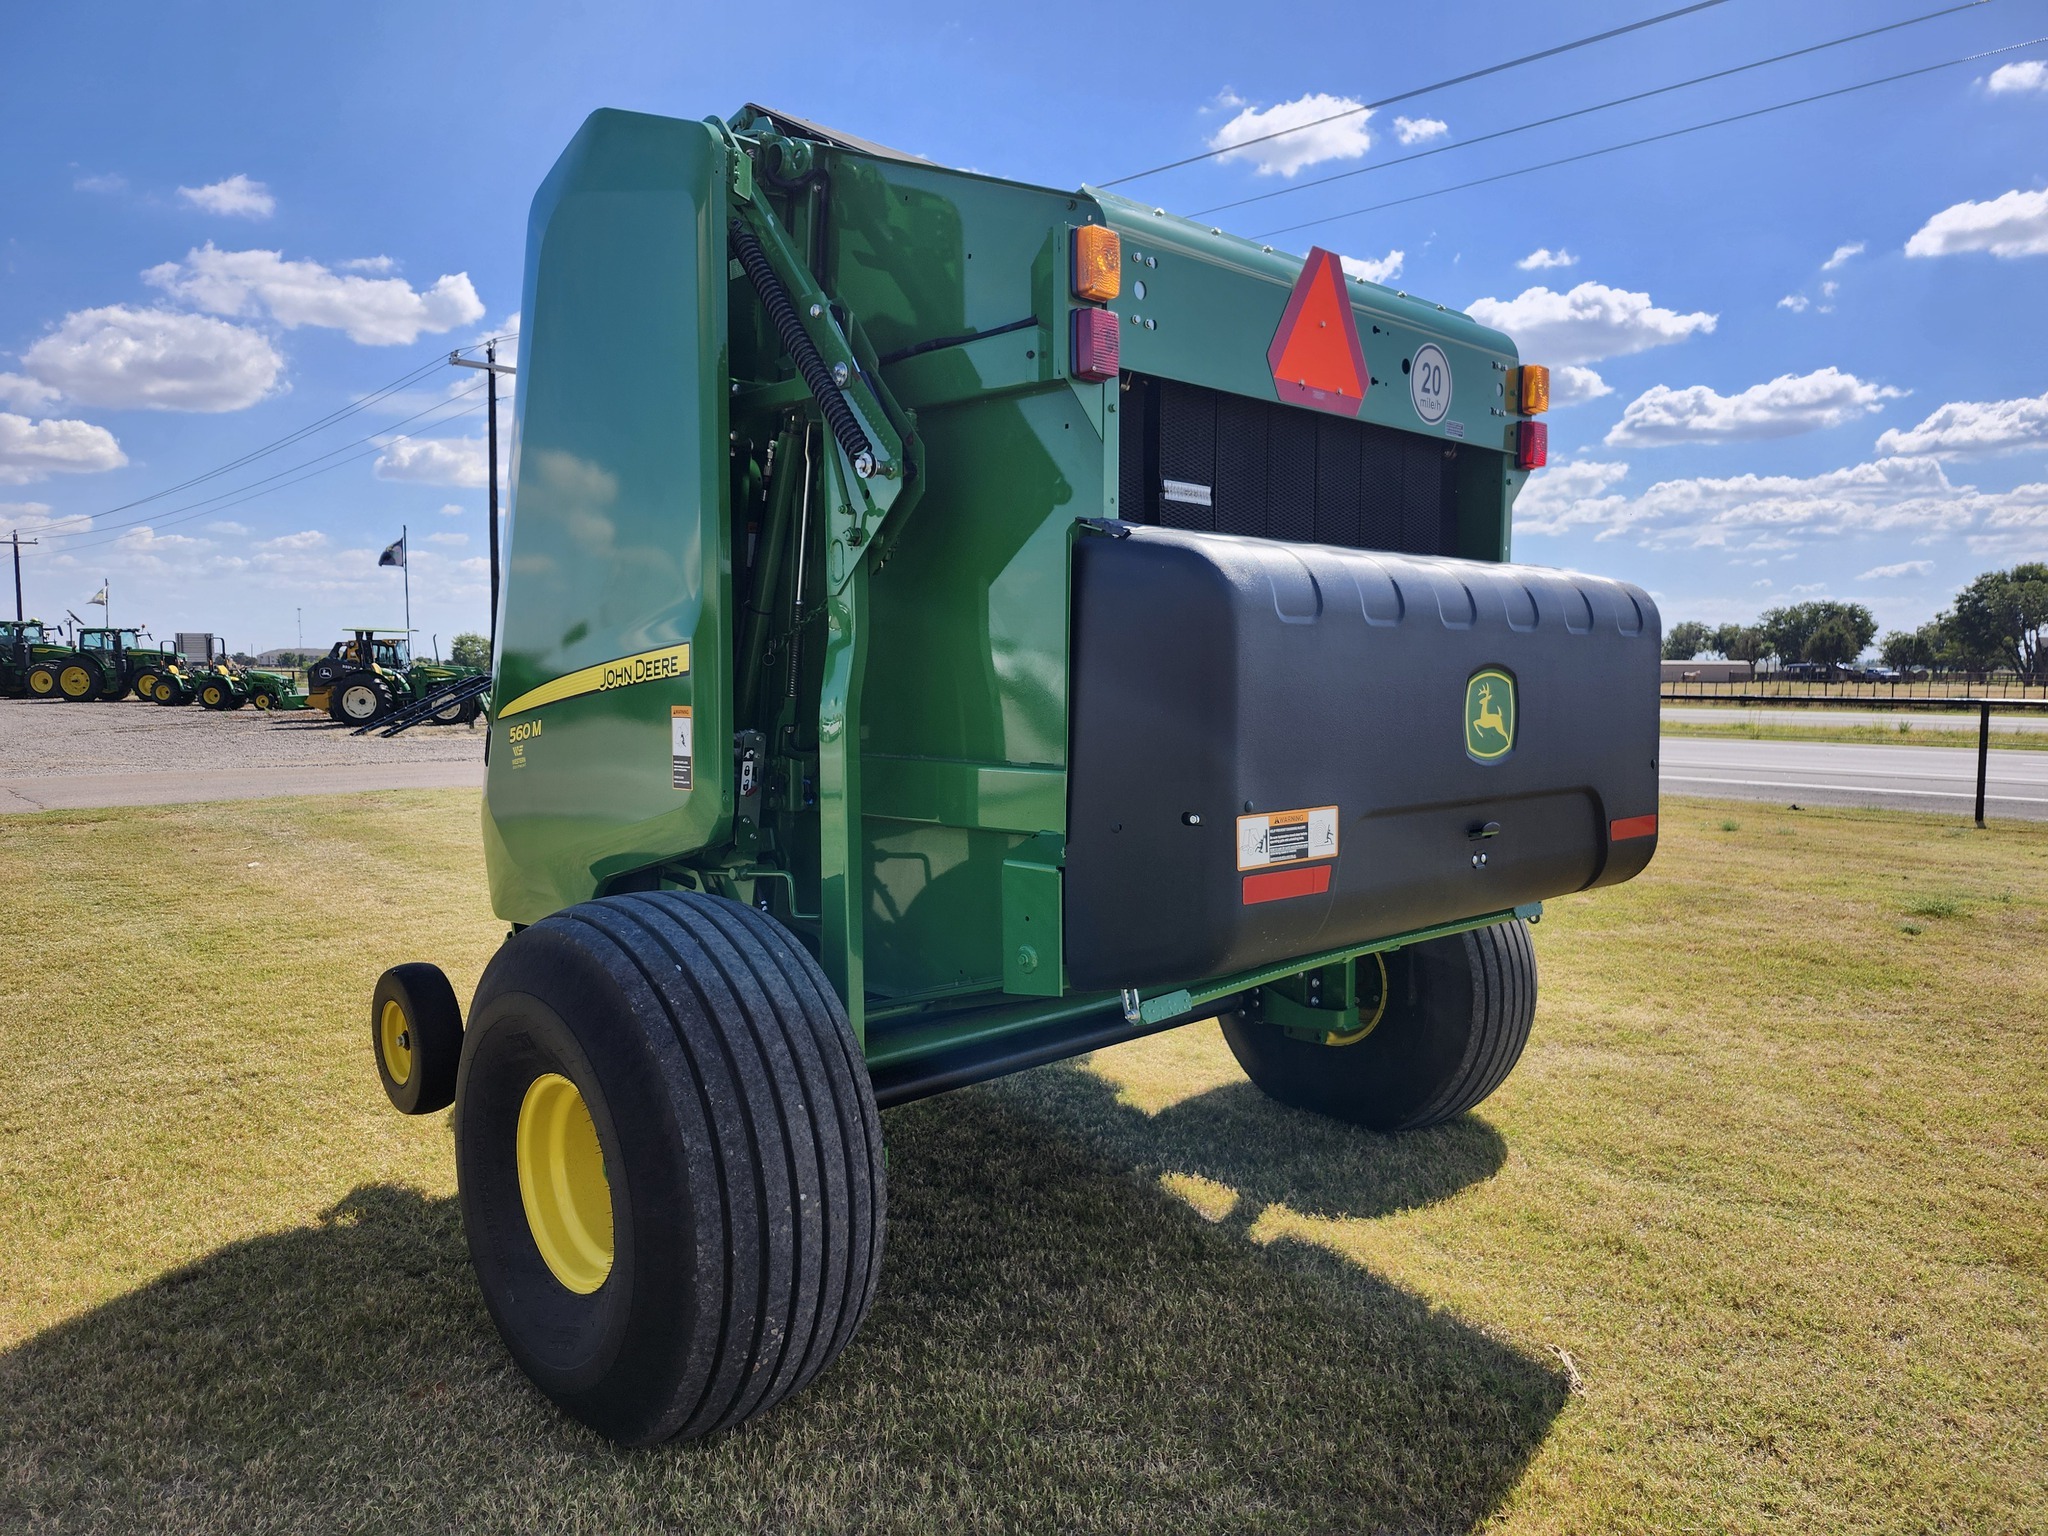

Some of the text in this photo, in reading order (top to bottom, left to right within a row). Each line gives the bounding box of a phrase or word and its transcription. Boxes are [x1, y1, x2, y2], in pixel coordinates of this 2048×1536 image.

[1421, 362, 1441, 396] 20
[1420, 398, 1441, 411] mile/h
[600, 656, 679, 689] JOHN DEERE
[509, 718, 542, 744] 560 M
